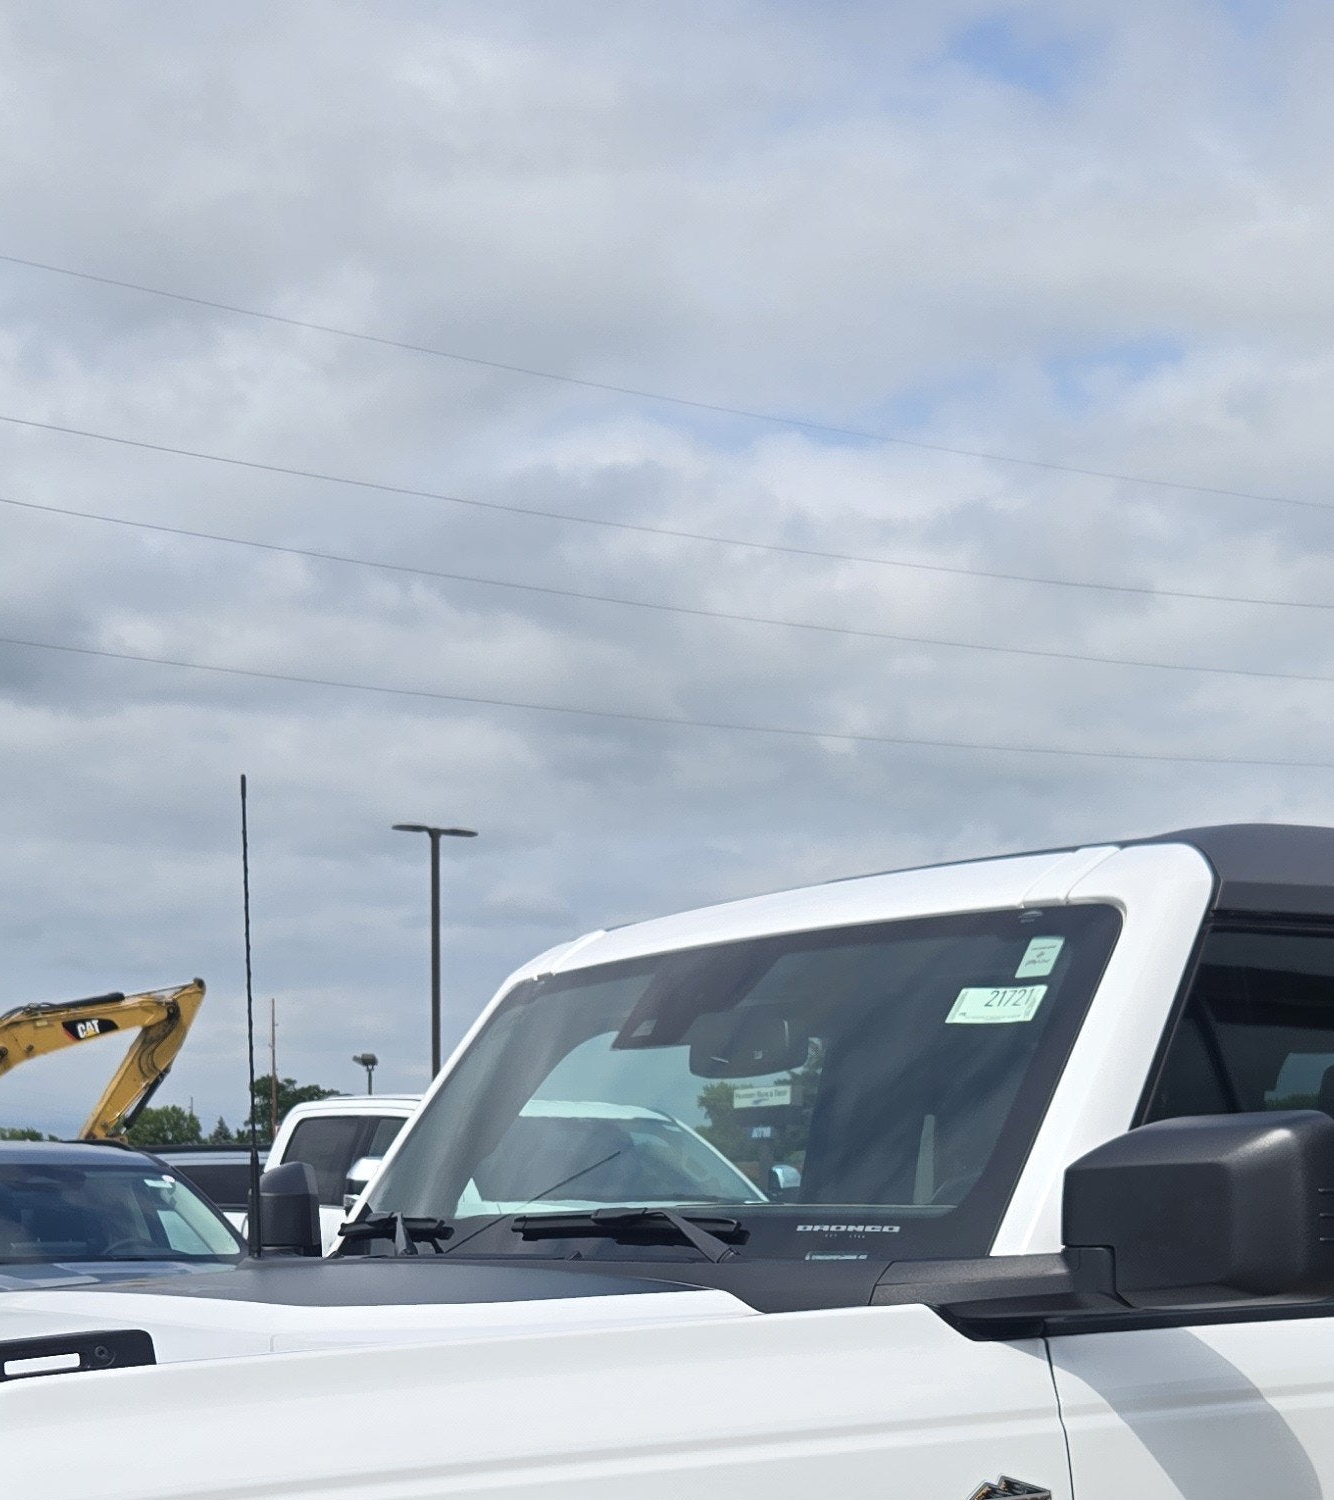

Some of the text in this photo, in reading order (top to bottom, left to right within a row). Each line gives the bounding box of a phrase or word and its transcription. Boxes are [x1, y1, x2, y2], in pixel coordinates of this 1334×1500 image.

[984, 988, 1035, 1008] 21721
[77, 1019, 100, 1039] CAT
[796, 1225, 901, 1233] BRONCO
